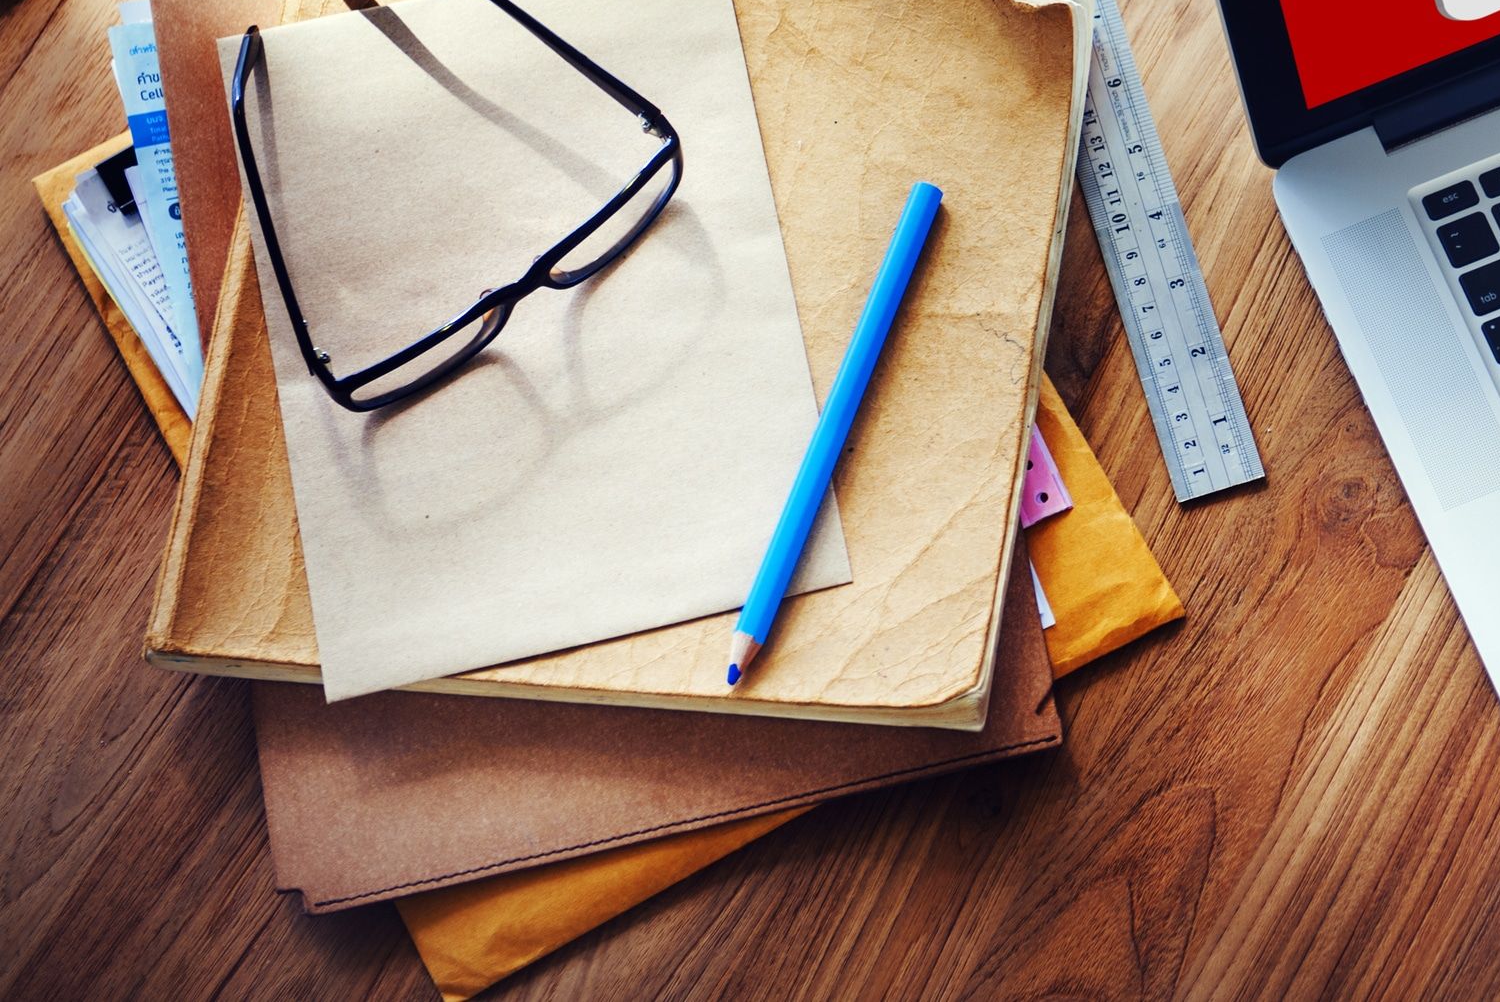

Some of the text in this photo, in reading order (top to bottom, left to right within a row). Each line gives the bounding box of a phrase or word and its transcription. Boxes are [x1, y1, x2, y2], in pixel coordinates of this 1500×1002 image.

[1107, 78, 1122, 88] 6
[1082, 109, 1097, 127] 14
[1089, 135, 1105, 153] 13
[1127, 144, 1143, 155] 5
[1098, 162, 1113, 179] 12
[1106, 188, 1122, 206] 11
[1443, 193, 1458, 203] esc
[1148, 210, 1163, 220] 4
[1111, 213, 1130, 234] 10
[1125, 251, 1139, 260] 9
[1133, 277, 1147, 287] 8
[1169, 278, 1185, 289] 3
[1481, 293, 1496, 303] tab
[1141, 305, 1155, 313] 7
[1150, 331, 1163, 340] 6
[1190, 346, 1206, 358] 2
[1159, 358, 1171, 367] 5
[1167, 385, 1180, 394] 4
[1175, 412, 1188, 422] 3
[1212, 415, 1228, 426] 1
[1184, 439, 1197, 450] 2
